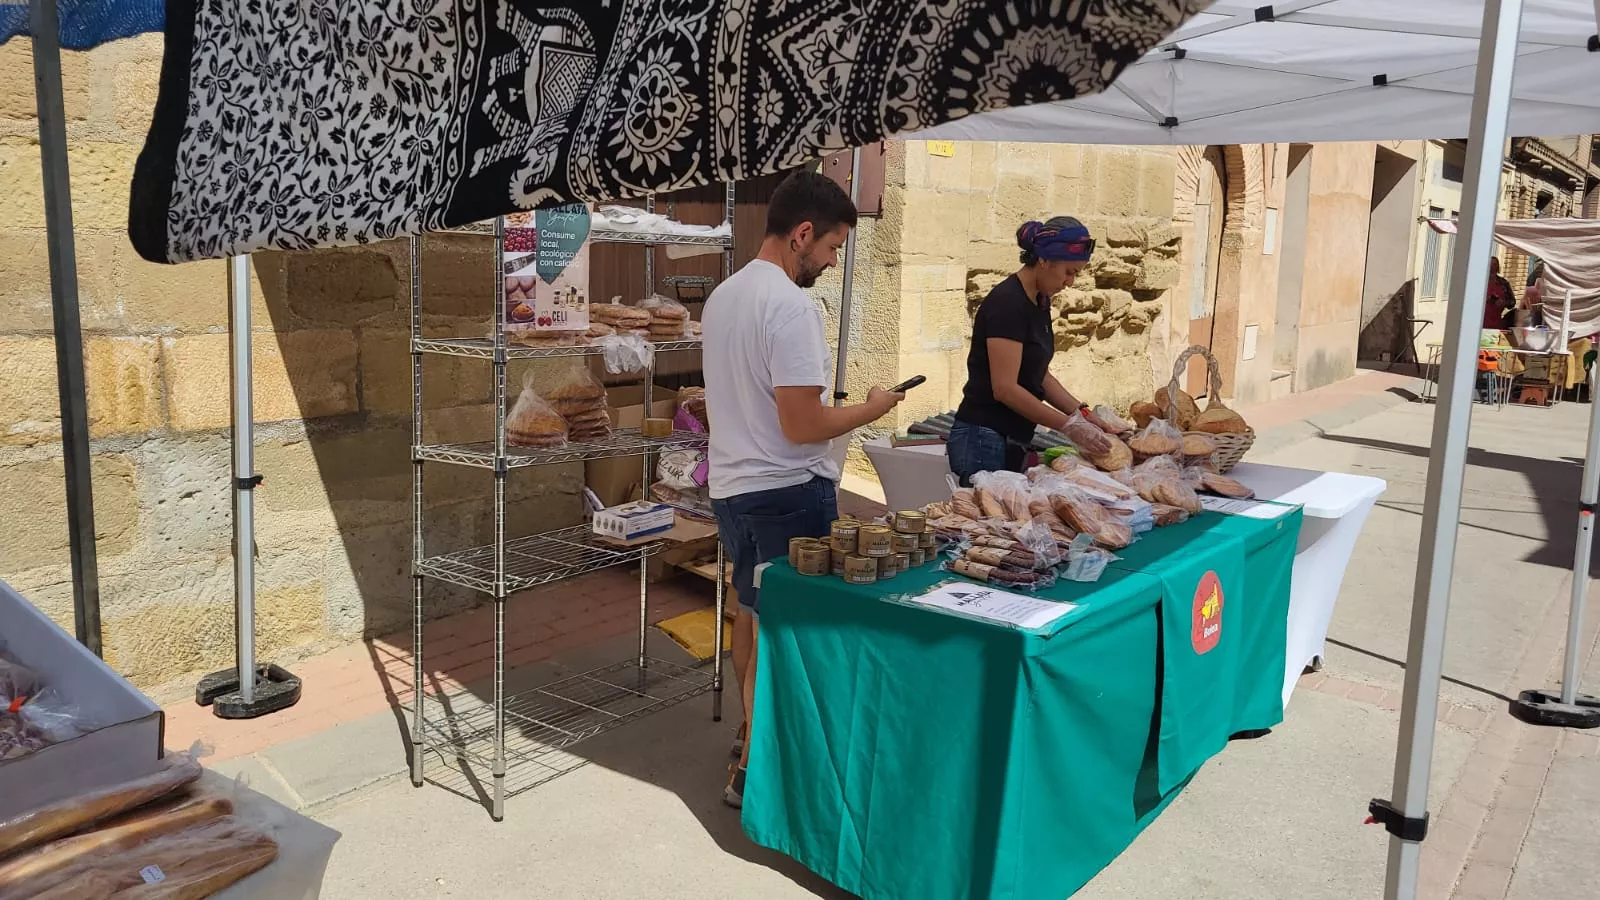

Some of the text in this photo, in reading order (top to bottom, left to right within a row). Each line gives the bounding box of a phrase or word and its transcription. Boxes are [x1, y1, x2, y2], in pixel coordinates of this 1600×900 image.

[541, 229, 576, 240] Consume
[541, 240, 560, 249] local,
[540, 250, 575, 259] ecológico
[554, 260, 580, 268] calid
[552, 310, 567, 322] CELI
